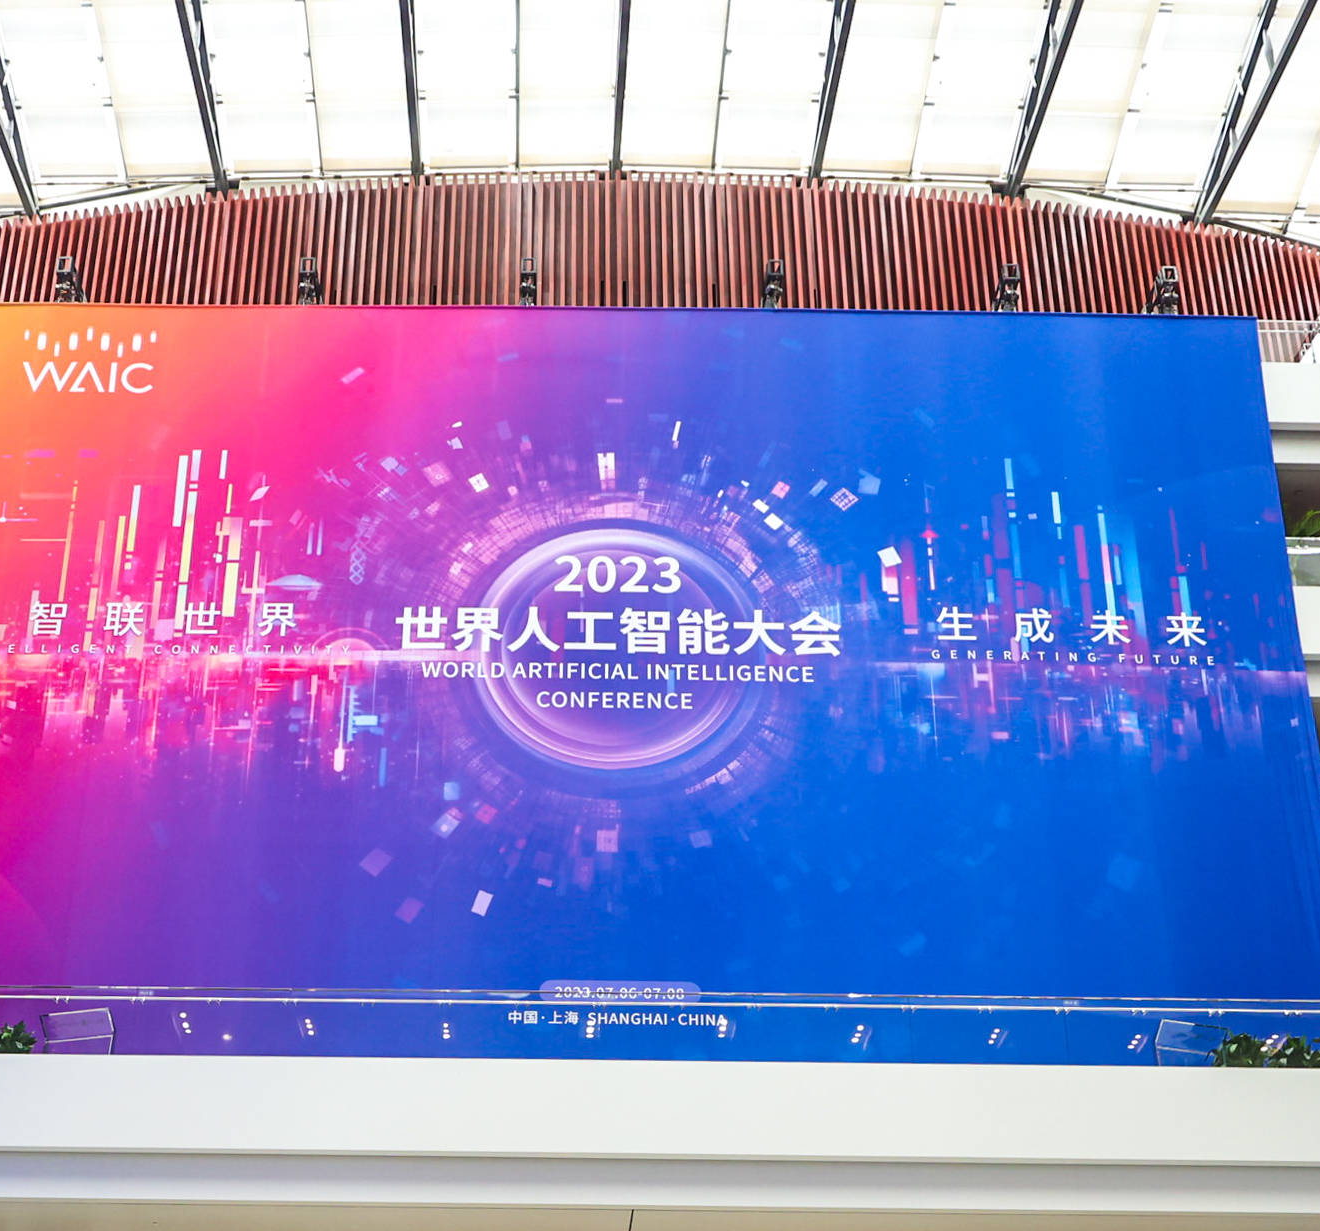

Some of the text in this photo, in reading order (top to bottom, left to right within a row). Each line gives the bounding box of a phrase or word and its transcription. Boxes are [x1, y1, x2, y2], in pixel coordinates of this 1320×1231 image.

[23, 361, 154, 393] WAIC
[553, 555, 682, 593] 2023
[30, 601, 298, 637] 智联世界
[395, 607, 842, 657] 世界人工智能大会
[936, 606, 1207, 647] 生成未来
[154, 645, 351, 656] CONNECTIVITY
[931, 649, 1216, 666] GENERATING FUTURE
[421, 662, 815, 683] WORLD ARTIFICIAL INTELLIGENCE
[536, 690, 694, 711] CONFERENCE
[508, 1010, 579, 1026] 中国·上海
